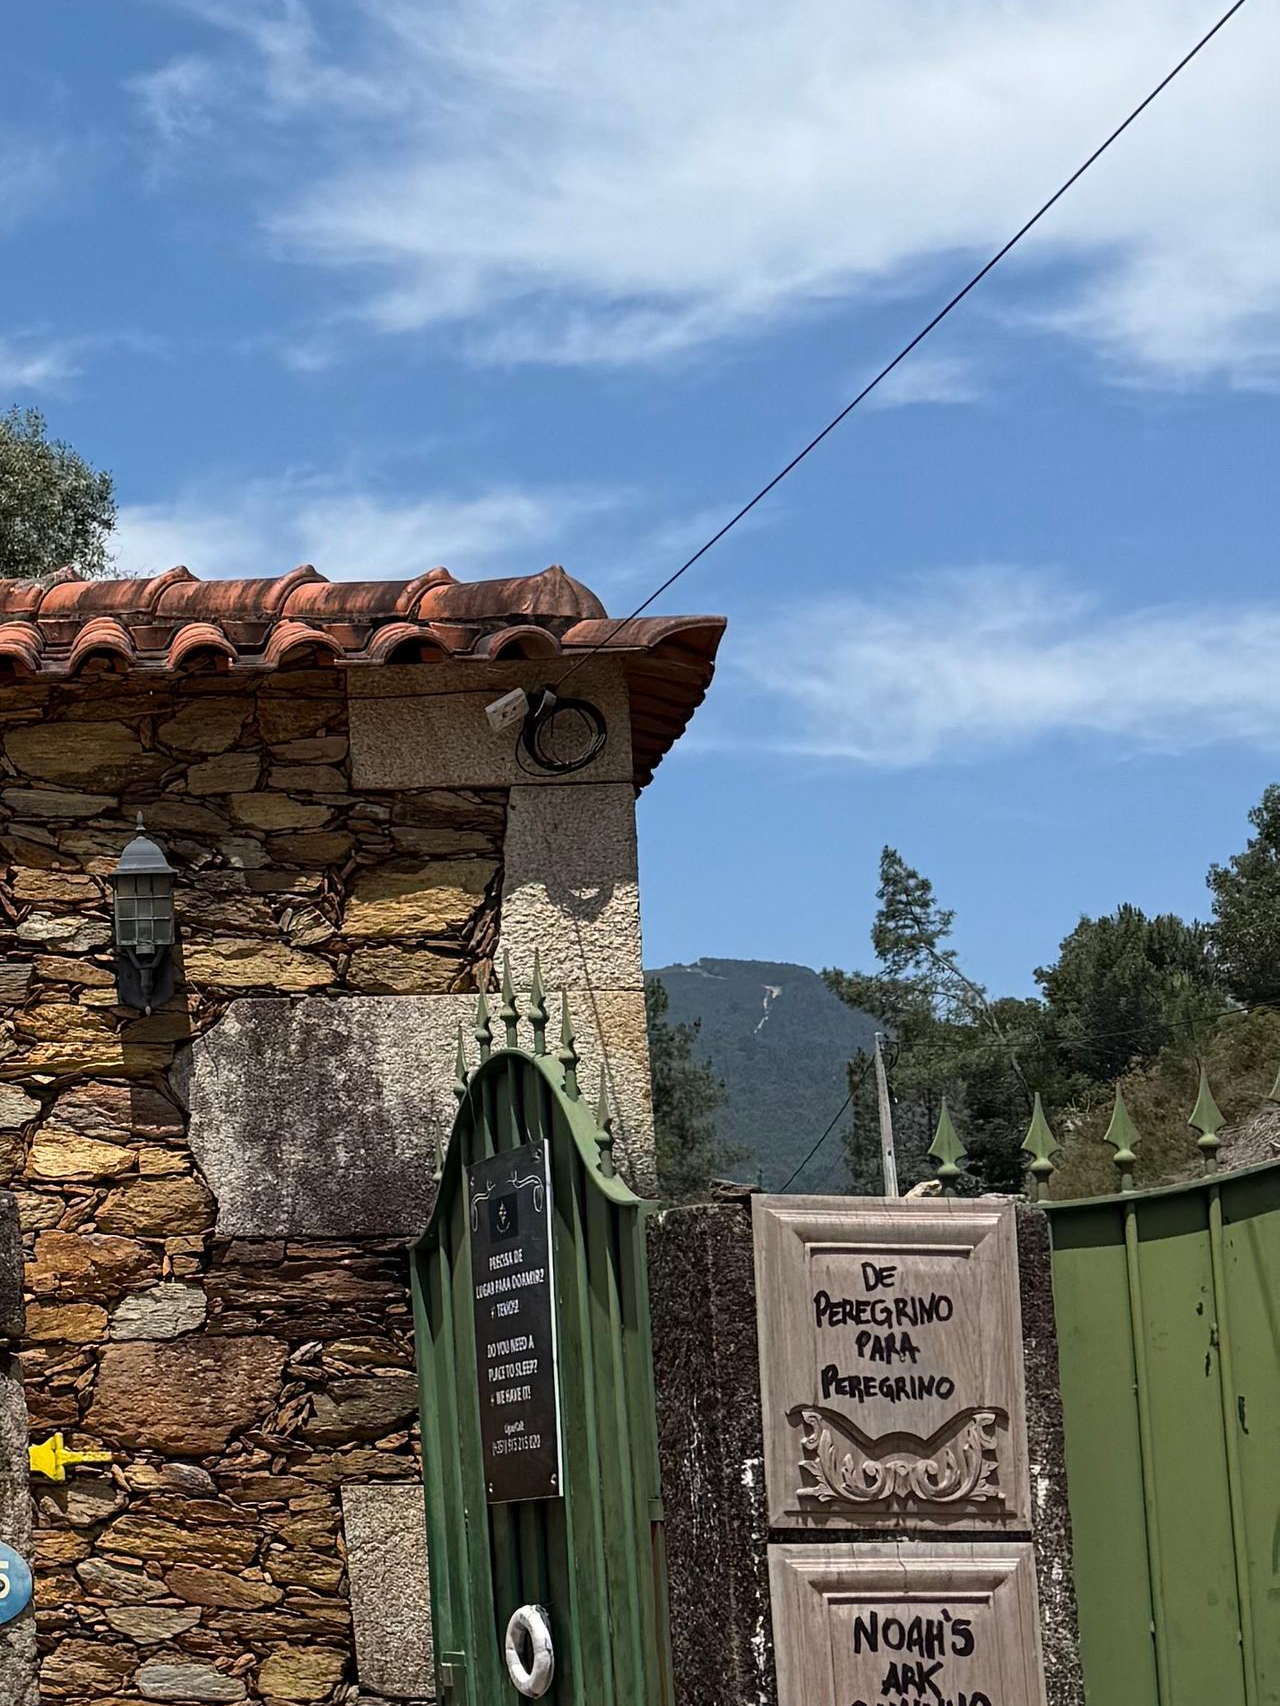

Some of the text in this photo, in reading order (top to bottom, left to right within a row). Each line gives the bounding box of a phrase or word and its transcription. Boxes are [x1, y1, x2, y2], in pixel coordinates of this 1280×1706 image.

[514, 1248, 523, 1263] DE
[861, 1261, 897, 1291] DE
[814, 1290, 953, 1328] PEREGRINO
[487, 1334, 534, 1358] DO YOU NEED A
[855, 1330, 921, 1364] PARA
[488, 1366, 505, 1382] PLACE
[506, 1363, 515, 1377] TO
[821, 1364, 955, 1403] PEREGRINO
[853, 1608, 975, 1659] NOAH'S
[881, 1661, 944, 1698] ARK
